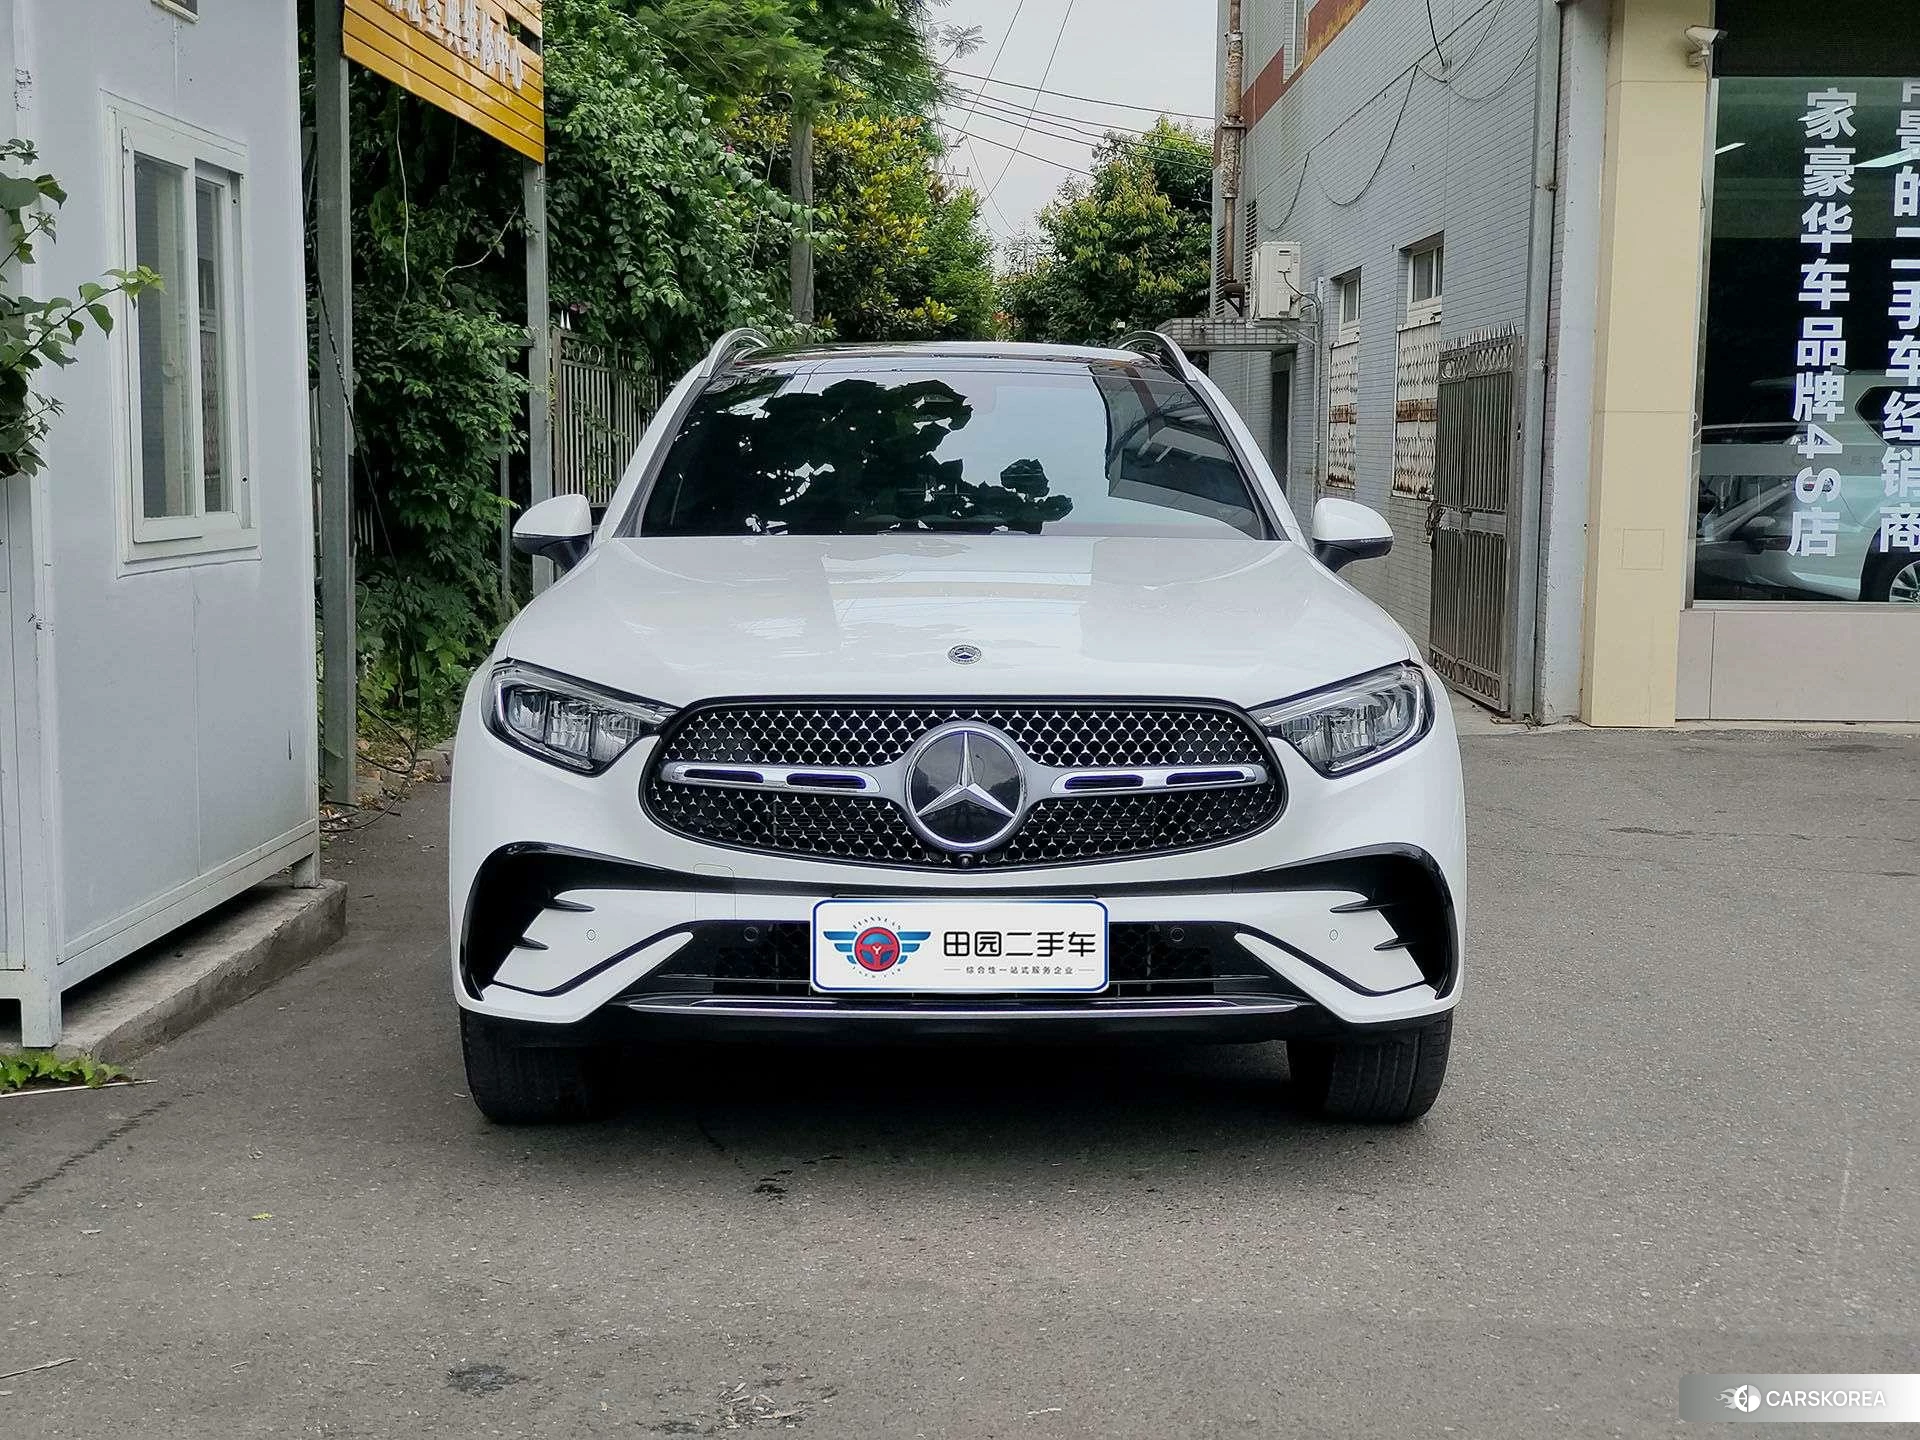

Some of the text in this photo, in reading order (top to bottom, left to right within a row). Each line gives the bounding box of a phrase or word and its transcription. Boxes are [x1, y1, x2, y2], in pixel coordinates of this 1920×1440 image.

[1787, 87, 1857, 557] 家豪华车品牌4S店
[944, 931, 1096, 957] 田园二手车
[966, 965, 1073, 975] 综合性一站式服务企业
